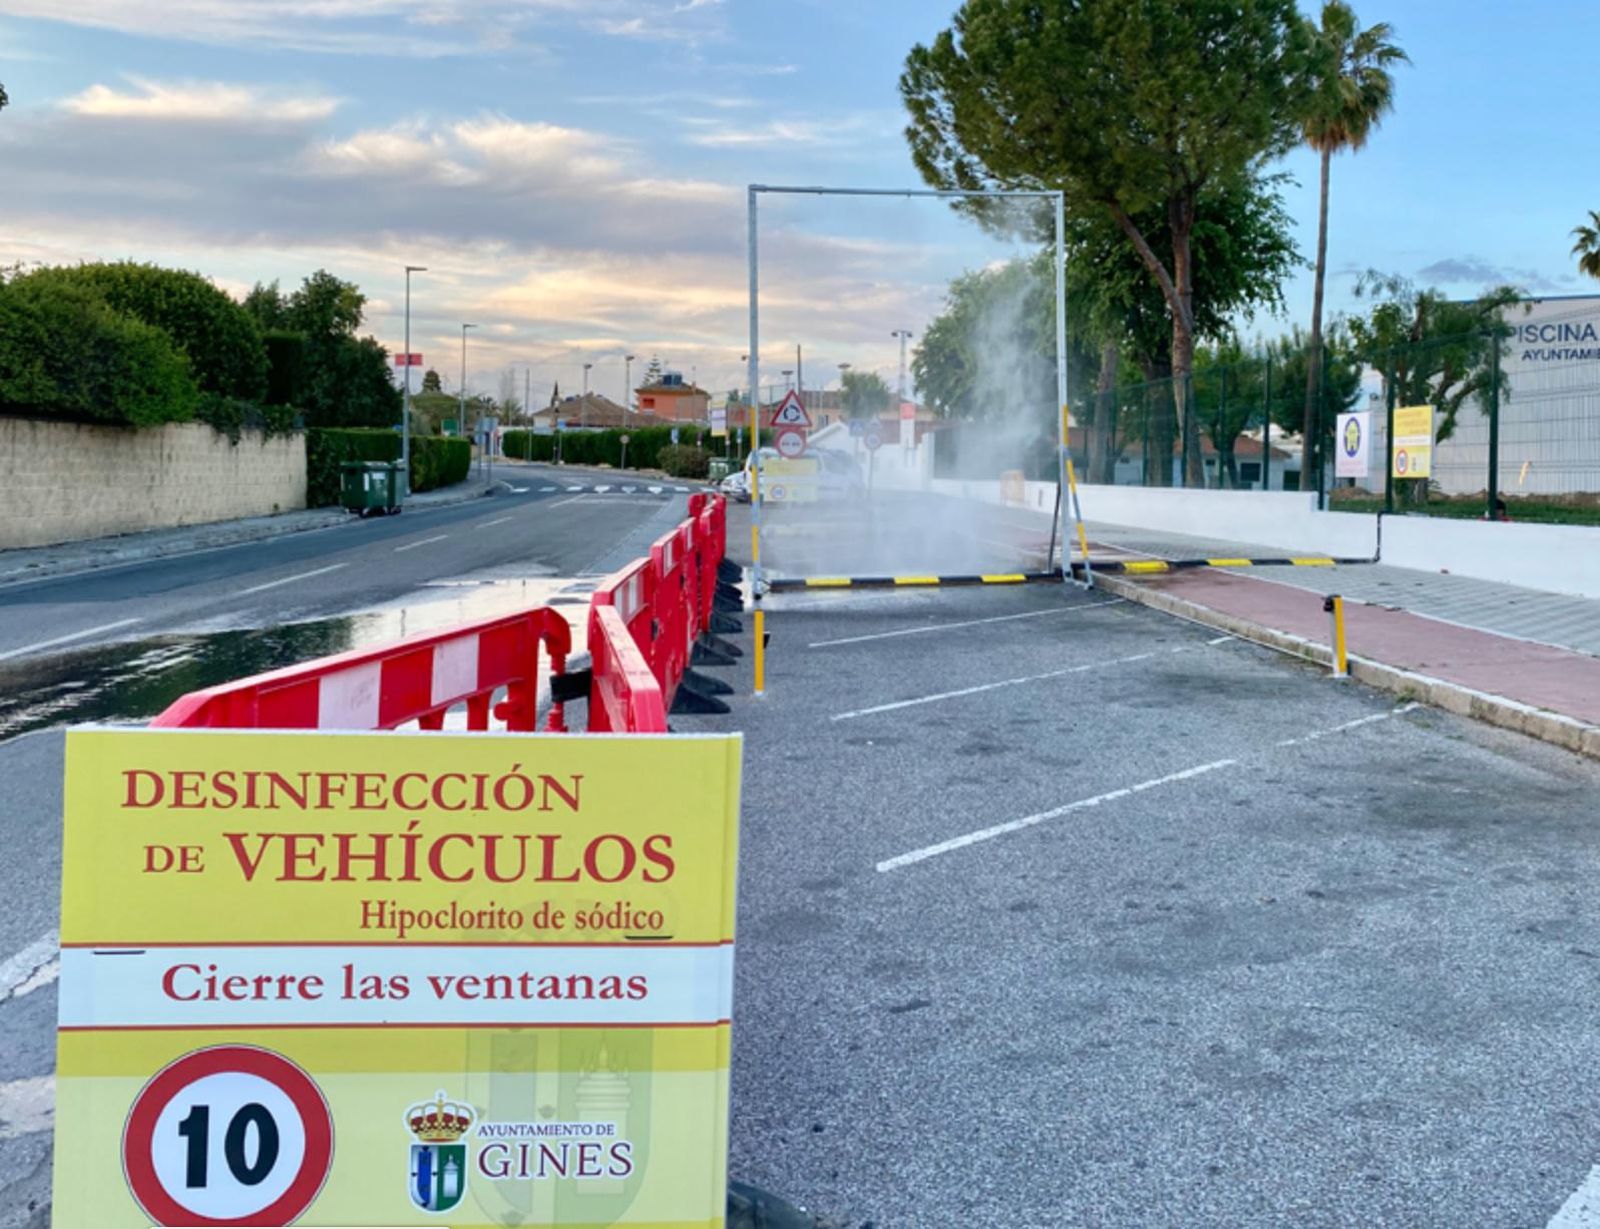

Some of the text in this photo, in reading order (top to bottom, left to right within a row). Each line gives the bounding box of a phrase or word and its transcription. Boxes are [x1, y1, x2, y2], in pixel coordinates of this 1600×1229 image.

[1502, 323, 1598, 343] PISCINA
[121, 763, 583, 812] DESINFECCIÓN
[143, 820, 676, 883] DE VEHÍCULOS
[360, 899, 664, 938] Hipoclorito de sódico
[162, 964, 648, 1001] Cierre las ventanas
[178, 1102, 280, 1188] 10
[478, 1124, 615, 1137] AYUNTAMIENTO DE
[478, 1142, 633, 1178] GINES
